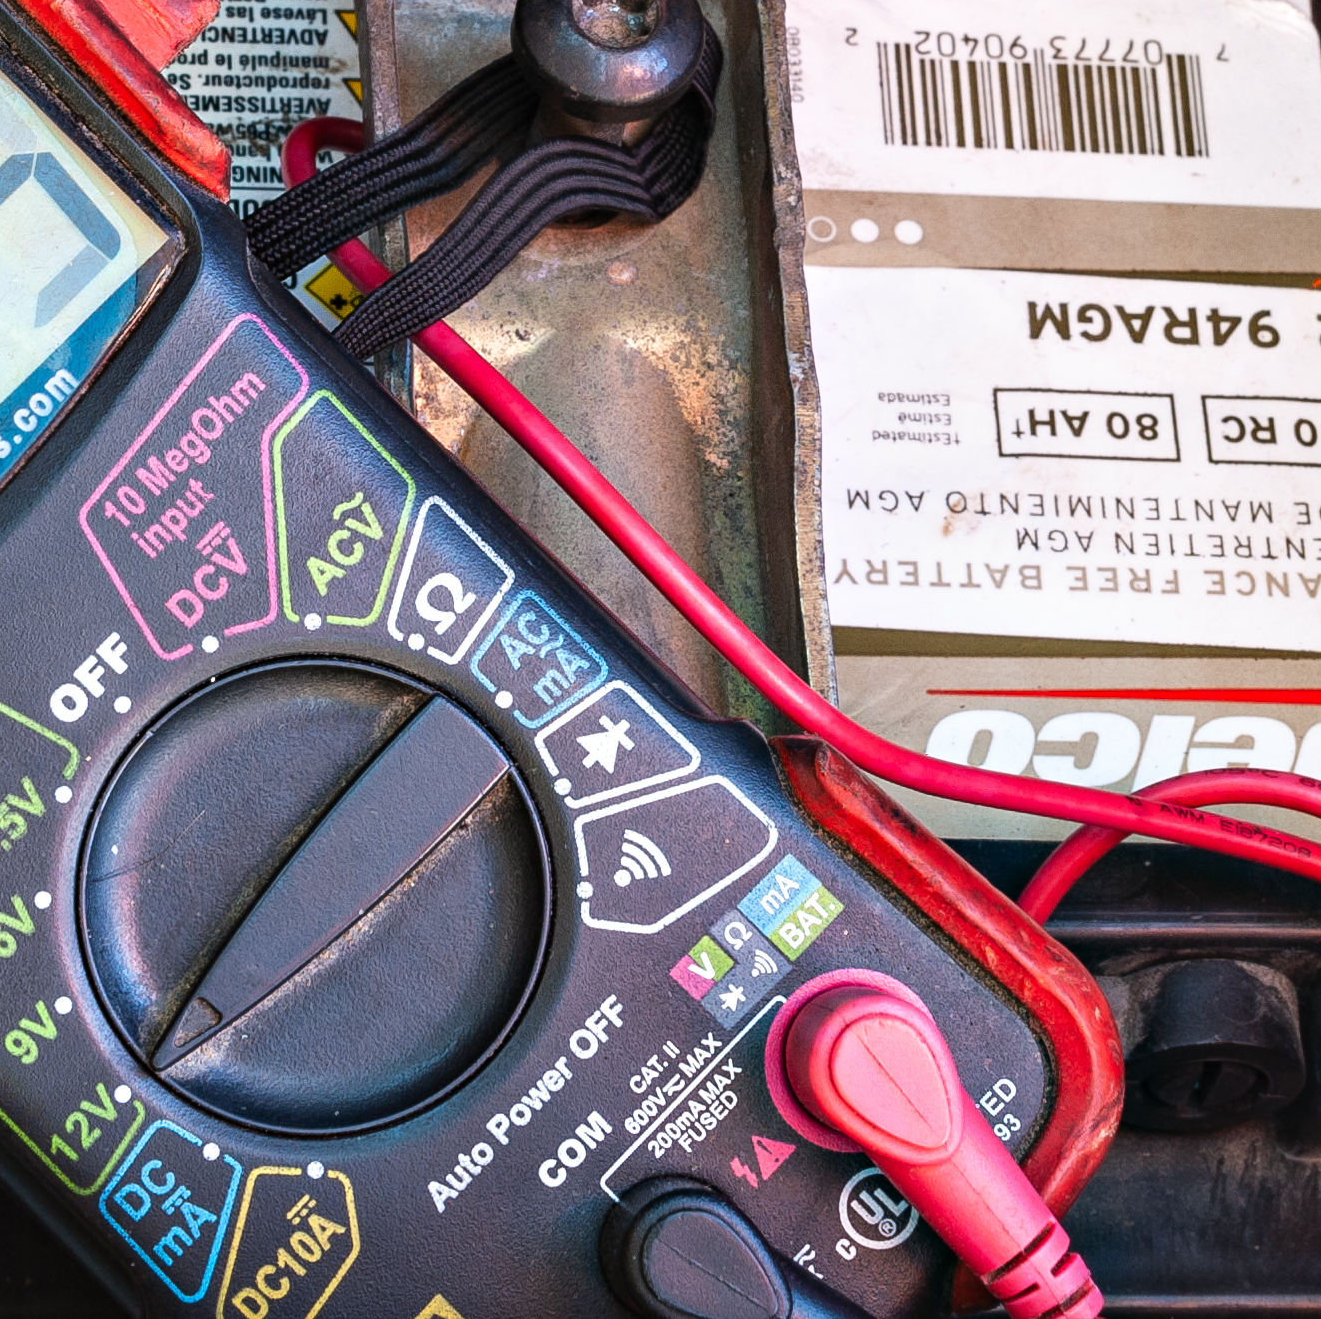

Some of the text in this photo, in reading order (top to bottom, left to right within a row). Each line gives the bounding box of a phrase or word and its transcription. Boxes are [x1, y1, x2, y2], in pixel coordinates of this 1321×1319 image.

[225, 7, 328, 25] Lávese las
[201, 26, 328, 46] ADVERTENCI
[844, 27, 1230, 66] 7 07773 90402 2
[215, 51, 330, 71] manipulé le
[167, 73, 330, 92] reproducteur. Se
[185, 95, 331, 114] AVERTISSEME
[1025, 300, 1281, 348] 94RAGM
[877, 391, 951, 407] Estimada
[898, 411, 952, 426] Estimé
[1106, 411, 1160, 441] 80
[1220, 416, 1277, 445] RC
[103, 371, 266, 529] 10 MegOhm
[132, 477, 215, 560] input
[846, 489, 925, 512] AGM
[944, 490, 1273, 524] MANTENIMIENTO
[1015, 527, 1094, 553] AGM
[832, 558, 1042, 591] BATTERY
[1066, 566, 1181, 595] FREE
[500, 611, 552, 670] AC
[50, 632, 128, 722] OFF
[532, 645, 590, 705] mA
[781, 897, 836, 949] BAT.
[688, 950, 714, 980] V
[5, 1001, 59, 1064] 9V
[681, 1032, 722, 1078] MAX
[629, 1059, 668, 1094] CAT.
[51, 1084, 117, 1161] 12V
[427, 994, 626, 1212] Auto Power OFF
[647, 1059, 742, 1158] 200mA MAX
[677, 1090, 739, 1153] FUSED
[537, 1112, 613, 1188] COM
[115, 1160, 176, 1220] DC
[153, 1199, 217, 1264] mA
